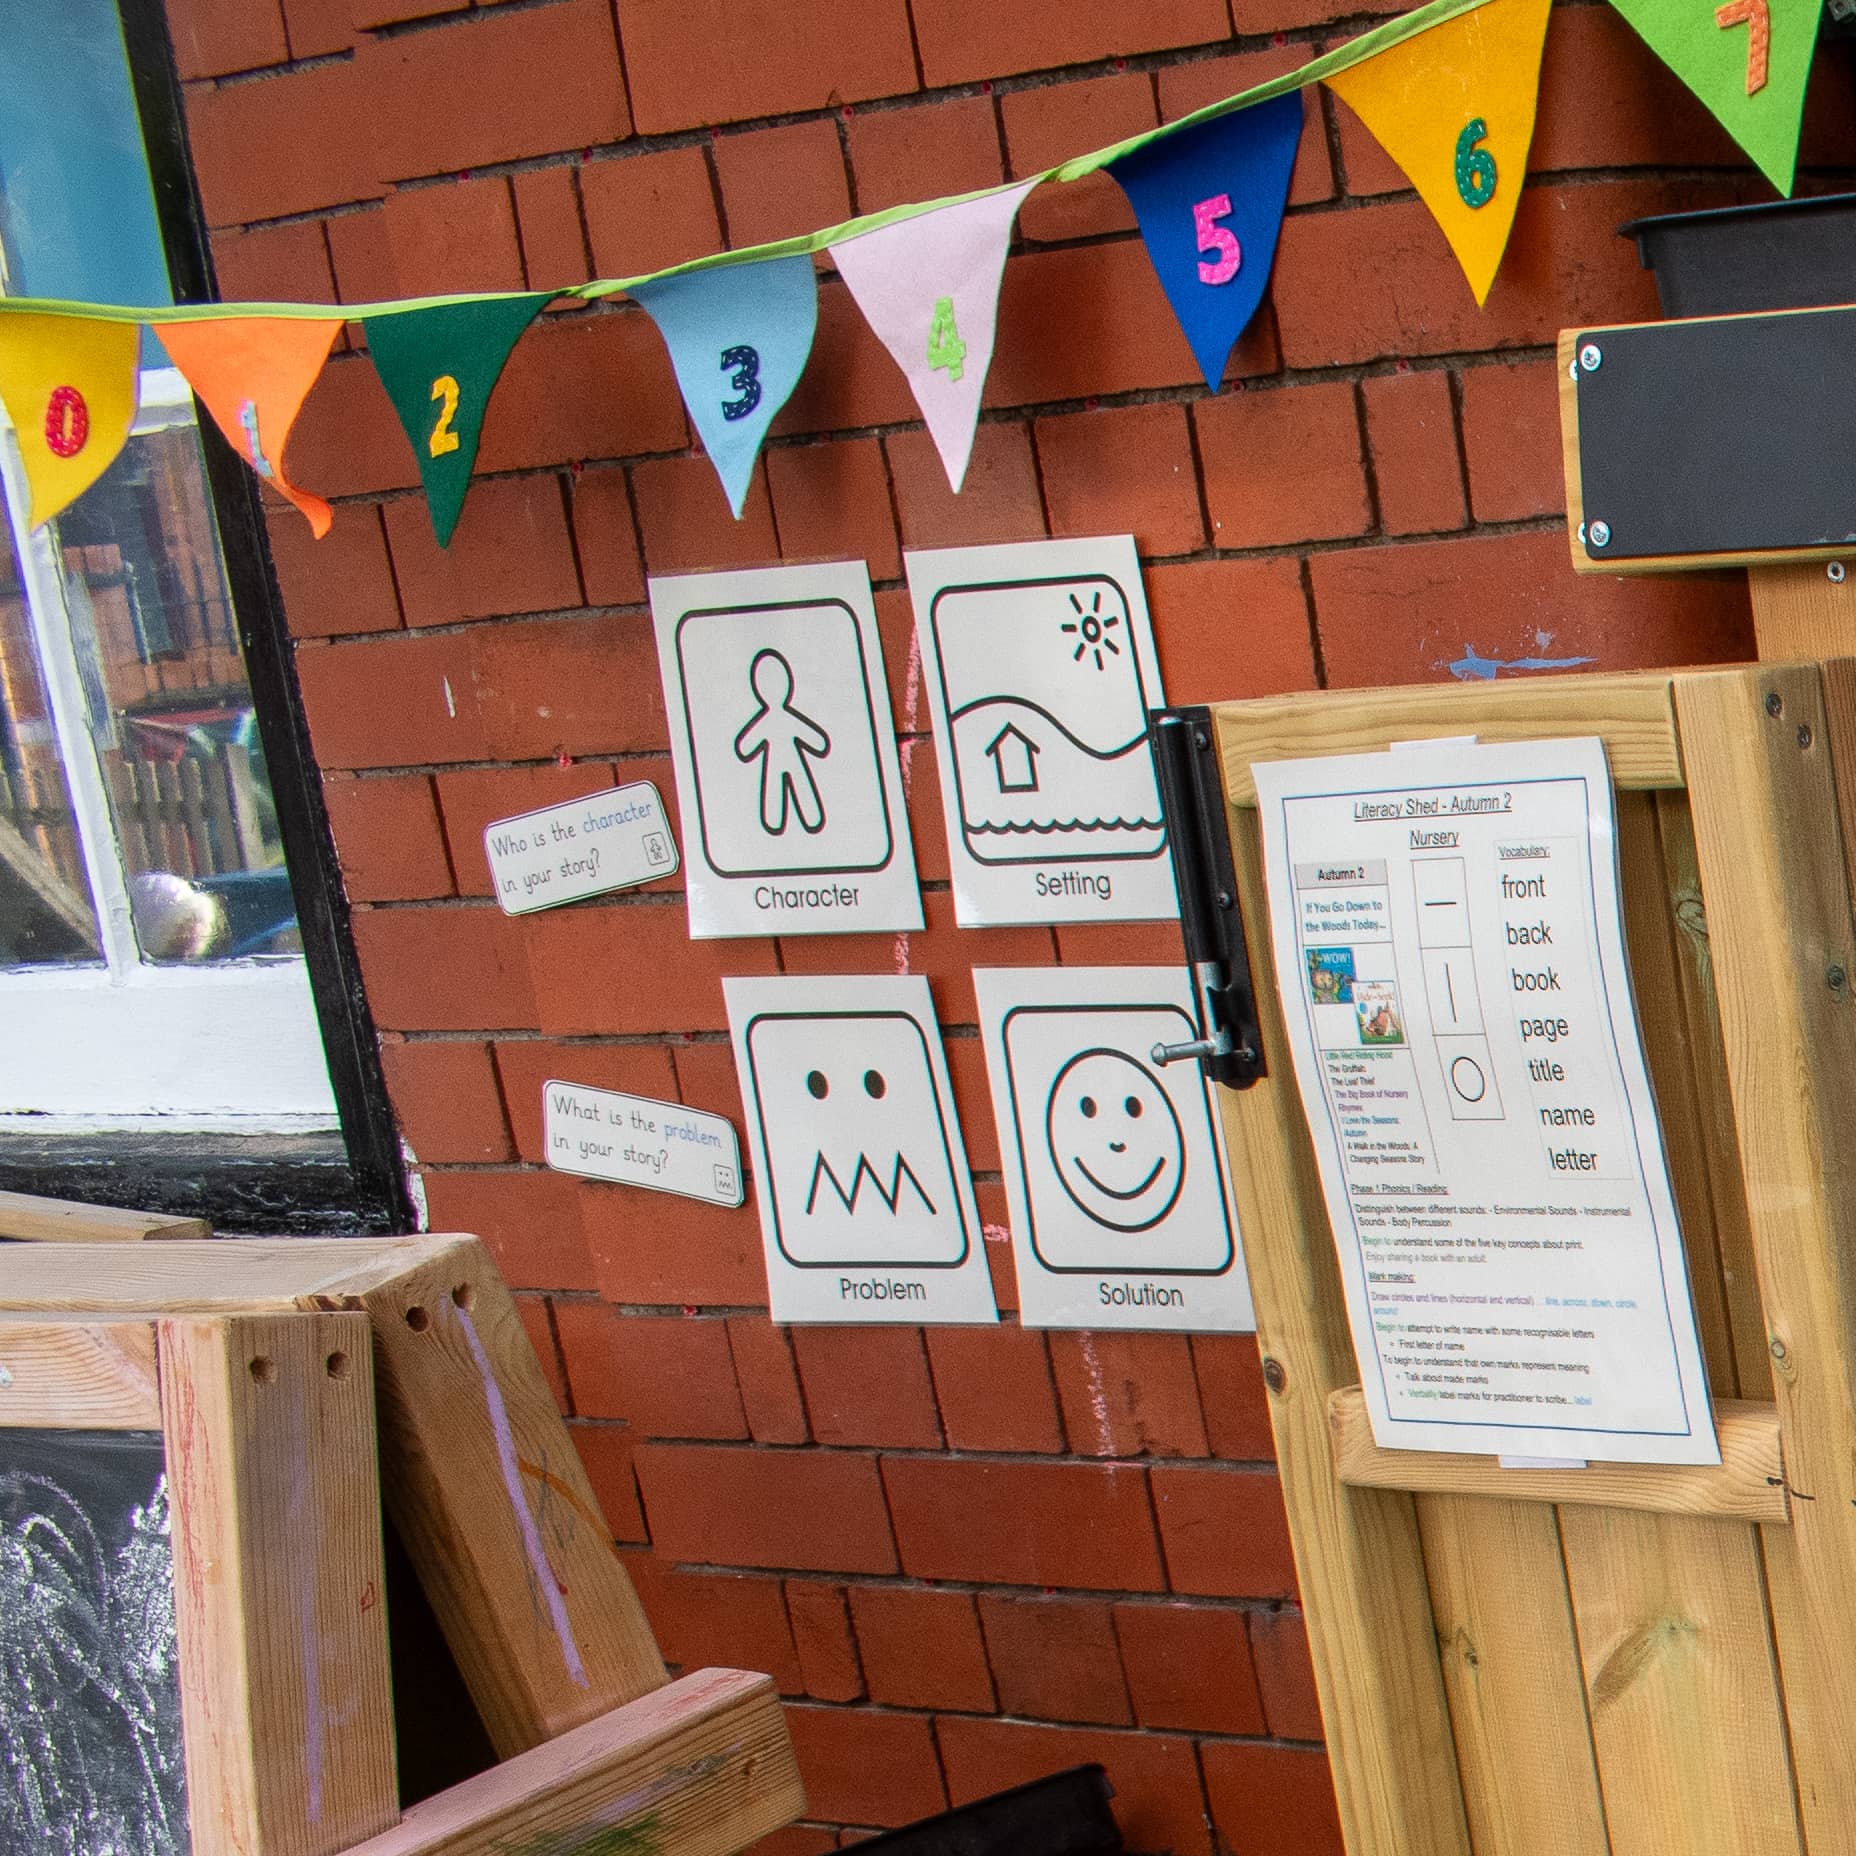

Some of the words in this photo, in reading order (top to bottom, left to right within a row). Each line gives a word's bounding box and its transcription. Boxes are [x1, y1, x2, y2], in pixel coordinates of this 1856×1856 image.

[1715, 0, 1770, 96] 7
[1455, 117, 1498, 209] 6
[1193, 194, 1242, 285] 5
[927, 296, 967, 382] 4
[720, 344, 762, 421] 3
[45, 385, 90, 459] 0
[428, 374, 461, 457] 2
[240, 400, 274, 478] 1
[1354, 798, 1403, 820] Literacy
[1406, 797, 1439, 816] Shed
[1451, 794, 1499, 812] Autumn
[1501, 793, 1512, 809] 2
[492, 836, 527, 858] Who
[532, 832, 546, 847] is
[550, 821, 576, 841] the
[583, 802, 652, 832] character
[1410, 829, 1459, 848] Nursery
[503, 879, 518, 893] in
[523, 869, 551, 894] your
[559, 847, 600, 877] story?
[1318, 867, 1354, 882] Autumn
[1355, 867, 1365, 879] 2
[754, 885, 858, 908] Character
[1035, 871, 1111, 899] Setting
[1502, 874, 1546, 899] front
[1506, 921, 1552, 945] back
[1512, 968, 1560, 992] book
[1520, 1017, 1569, 1041] page
[1528, 1059, 1564, 1083] title
[555, 1095, 600, 1120] What
[609, 1110, 622, 1125] is
[629, 1110, 656, 1132] the
[663, 1122, 721, 1147] problem
[1540, 1107, 1595, 1127] name
[553, 1133, 569, 1149] in
[578, 1140, 613, 1159] your
[623, 1144, 668, 1173] story?
[1548, 1147, 1598, 1172] letter
[839, 1278, 926, 1299] Problem
[1098, 1282, 1184, 1306] Solution
